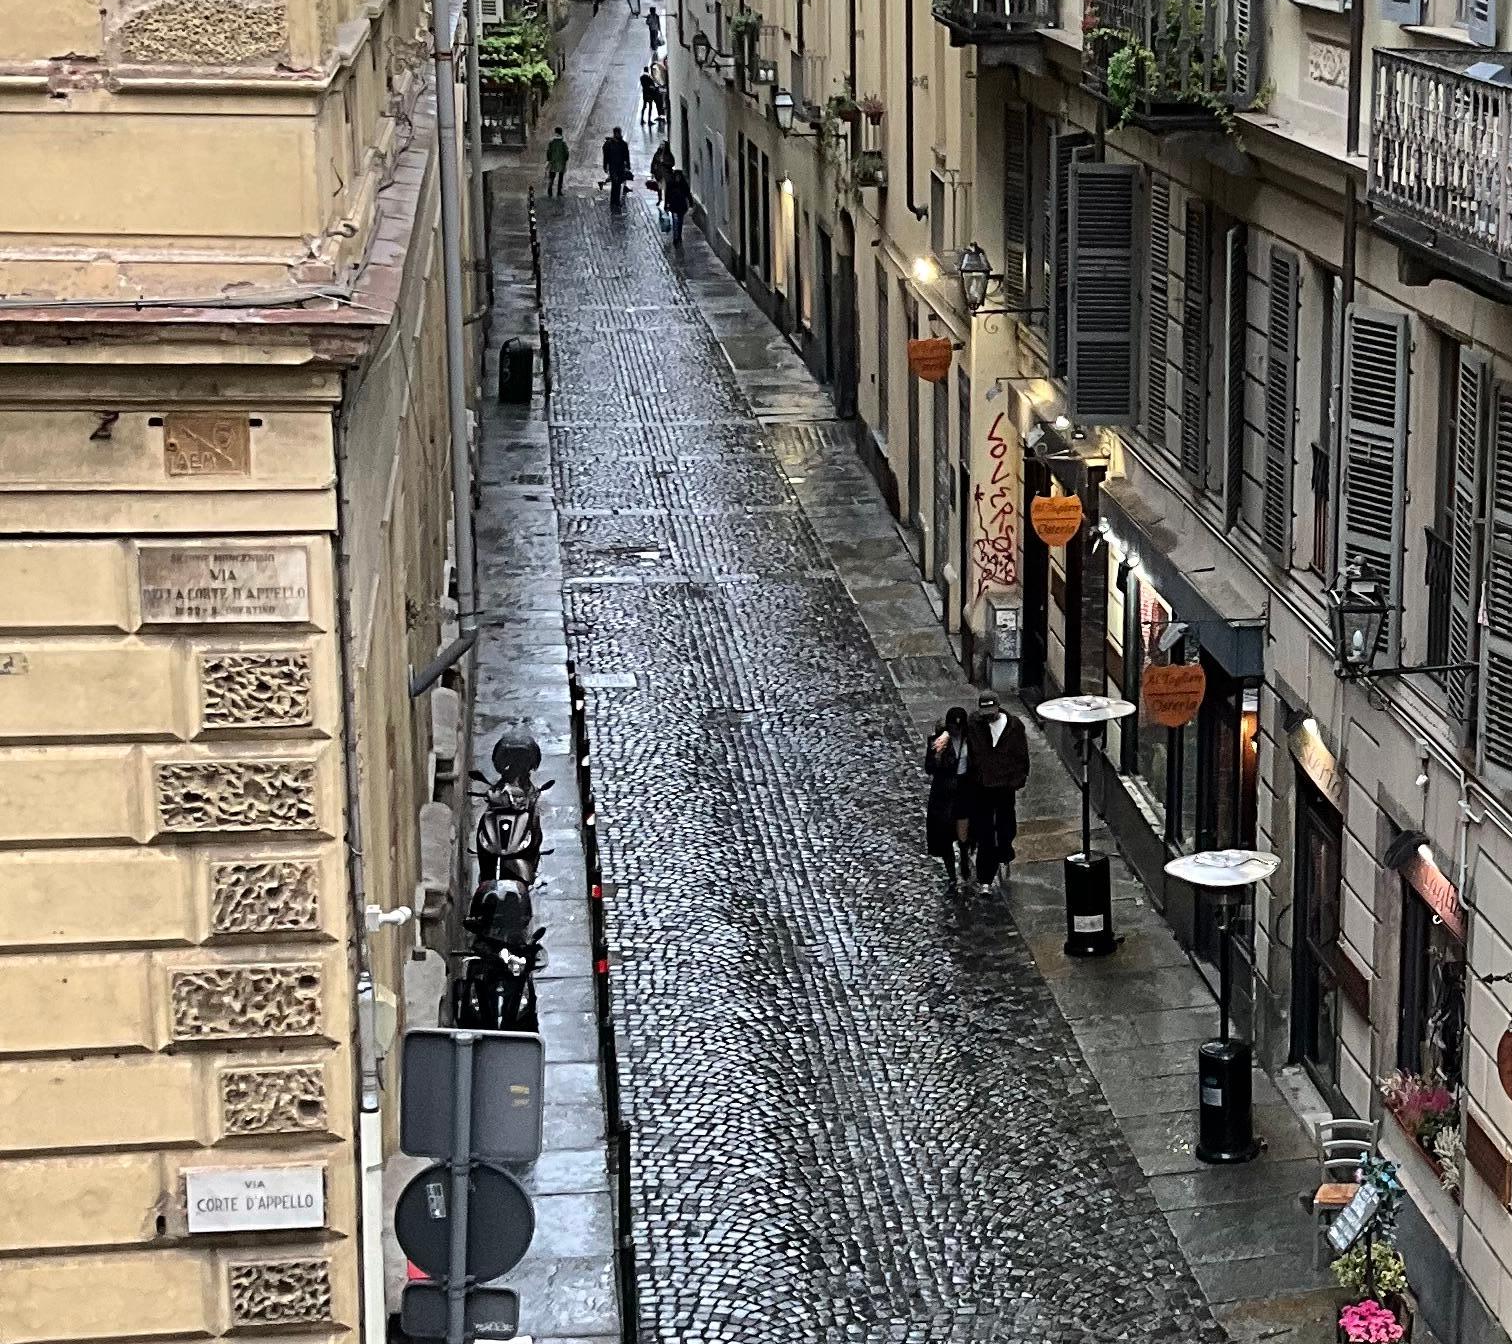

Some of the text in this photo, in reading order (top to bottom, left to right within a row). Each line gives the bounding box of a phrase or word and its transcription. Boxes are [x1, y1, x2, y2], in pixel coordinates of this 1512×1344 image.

[209, 568, 238, 582] VIA
[187, 587, 227, 601] CORTE
[232, 586, 306, 601] D'APPELLO
[244, 1180, 266, 1189] VIA
[196, 1193, 314, 1213] CORTE D'APPELLO
